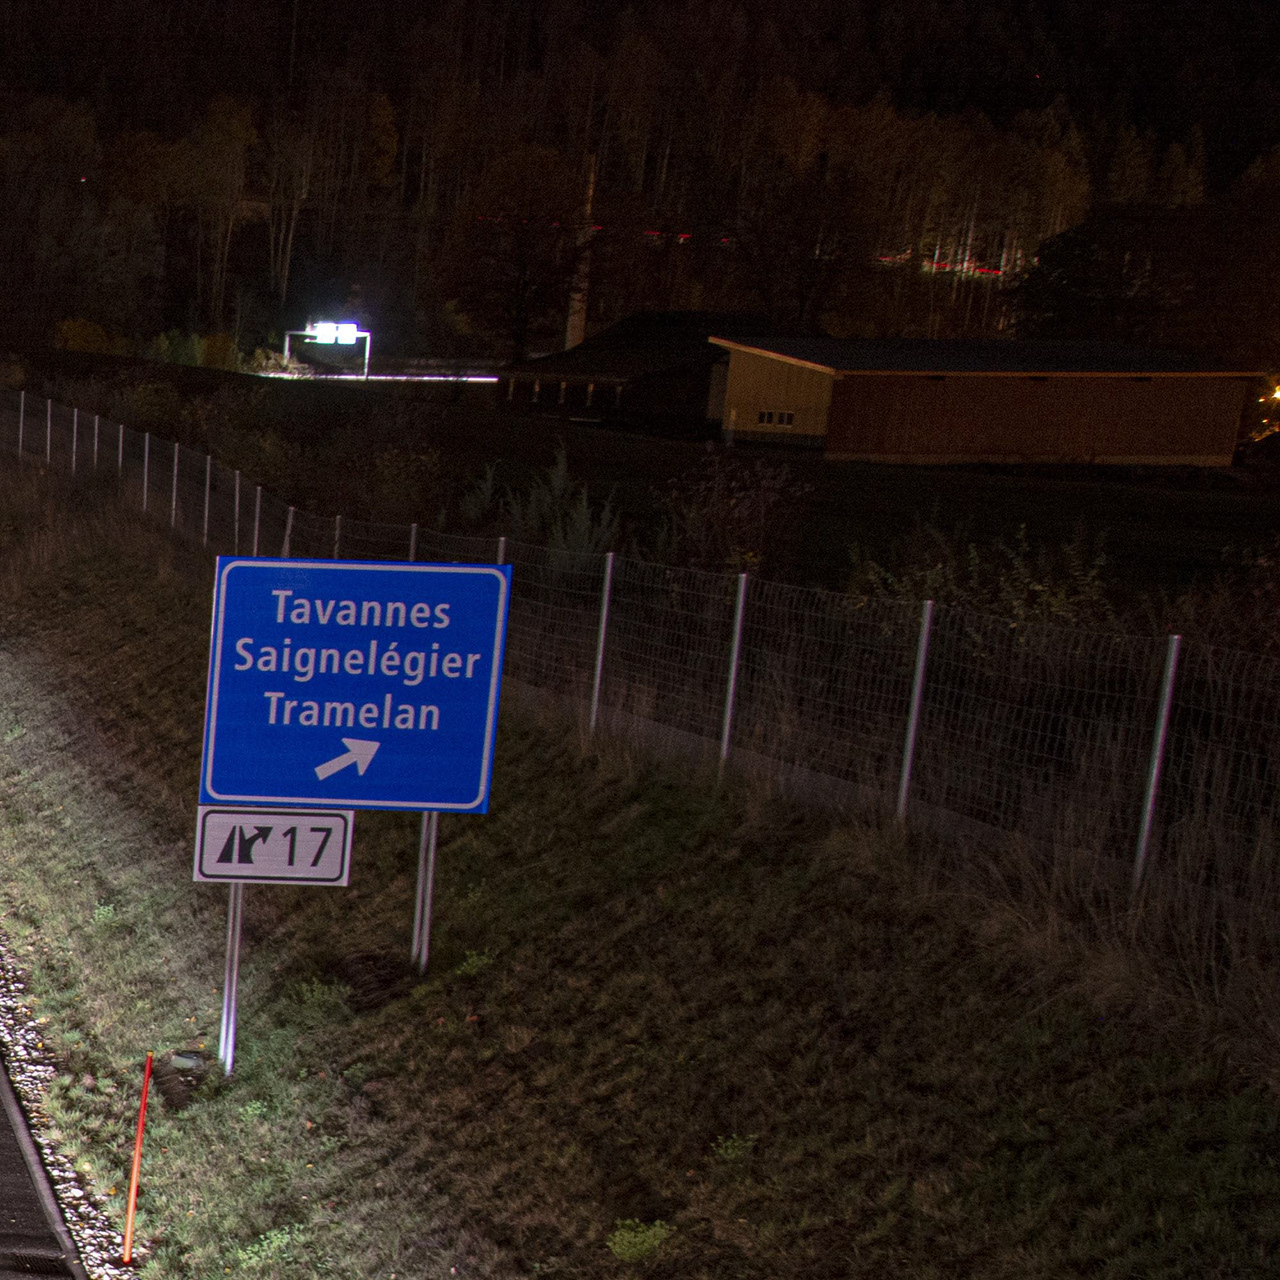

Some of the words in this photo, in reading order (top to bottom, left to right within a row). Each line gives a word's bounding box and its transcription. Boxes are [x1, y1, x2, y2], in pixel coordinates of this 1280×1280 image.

[272, 589, 451, 628] Tavannes
[234, 637, 481, 686] Saignelégier
[263, 691, 440, 730] Tramelan
[282, 826, 333, 868] 17
